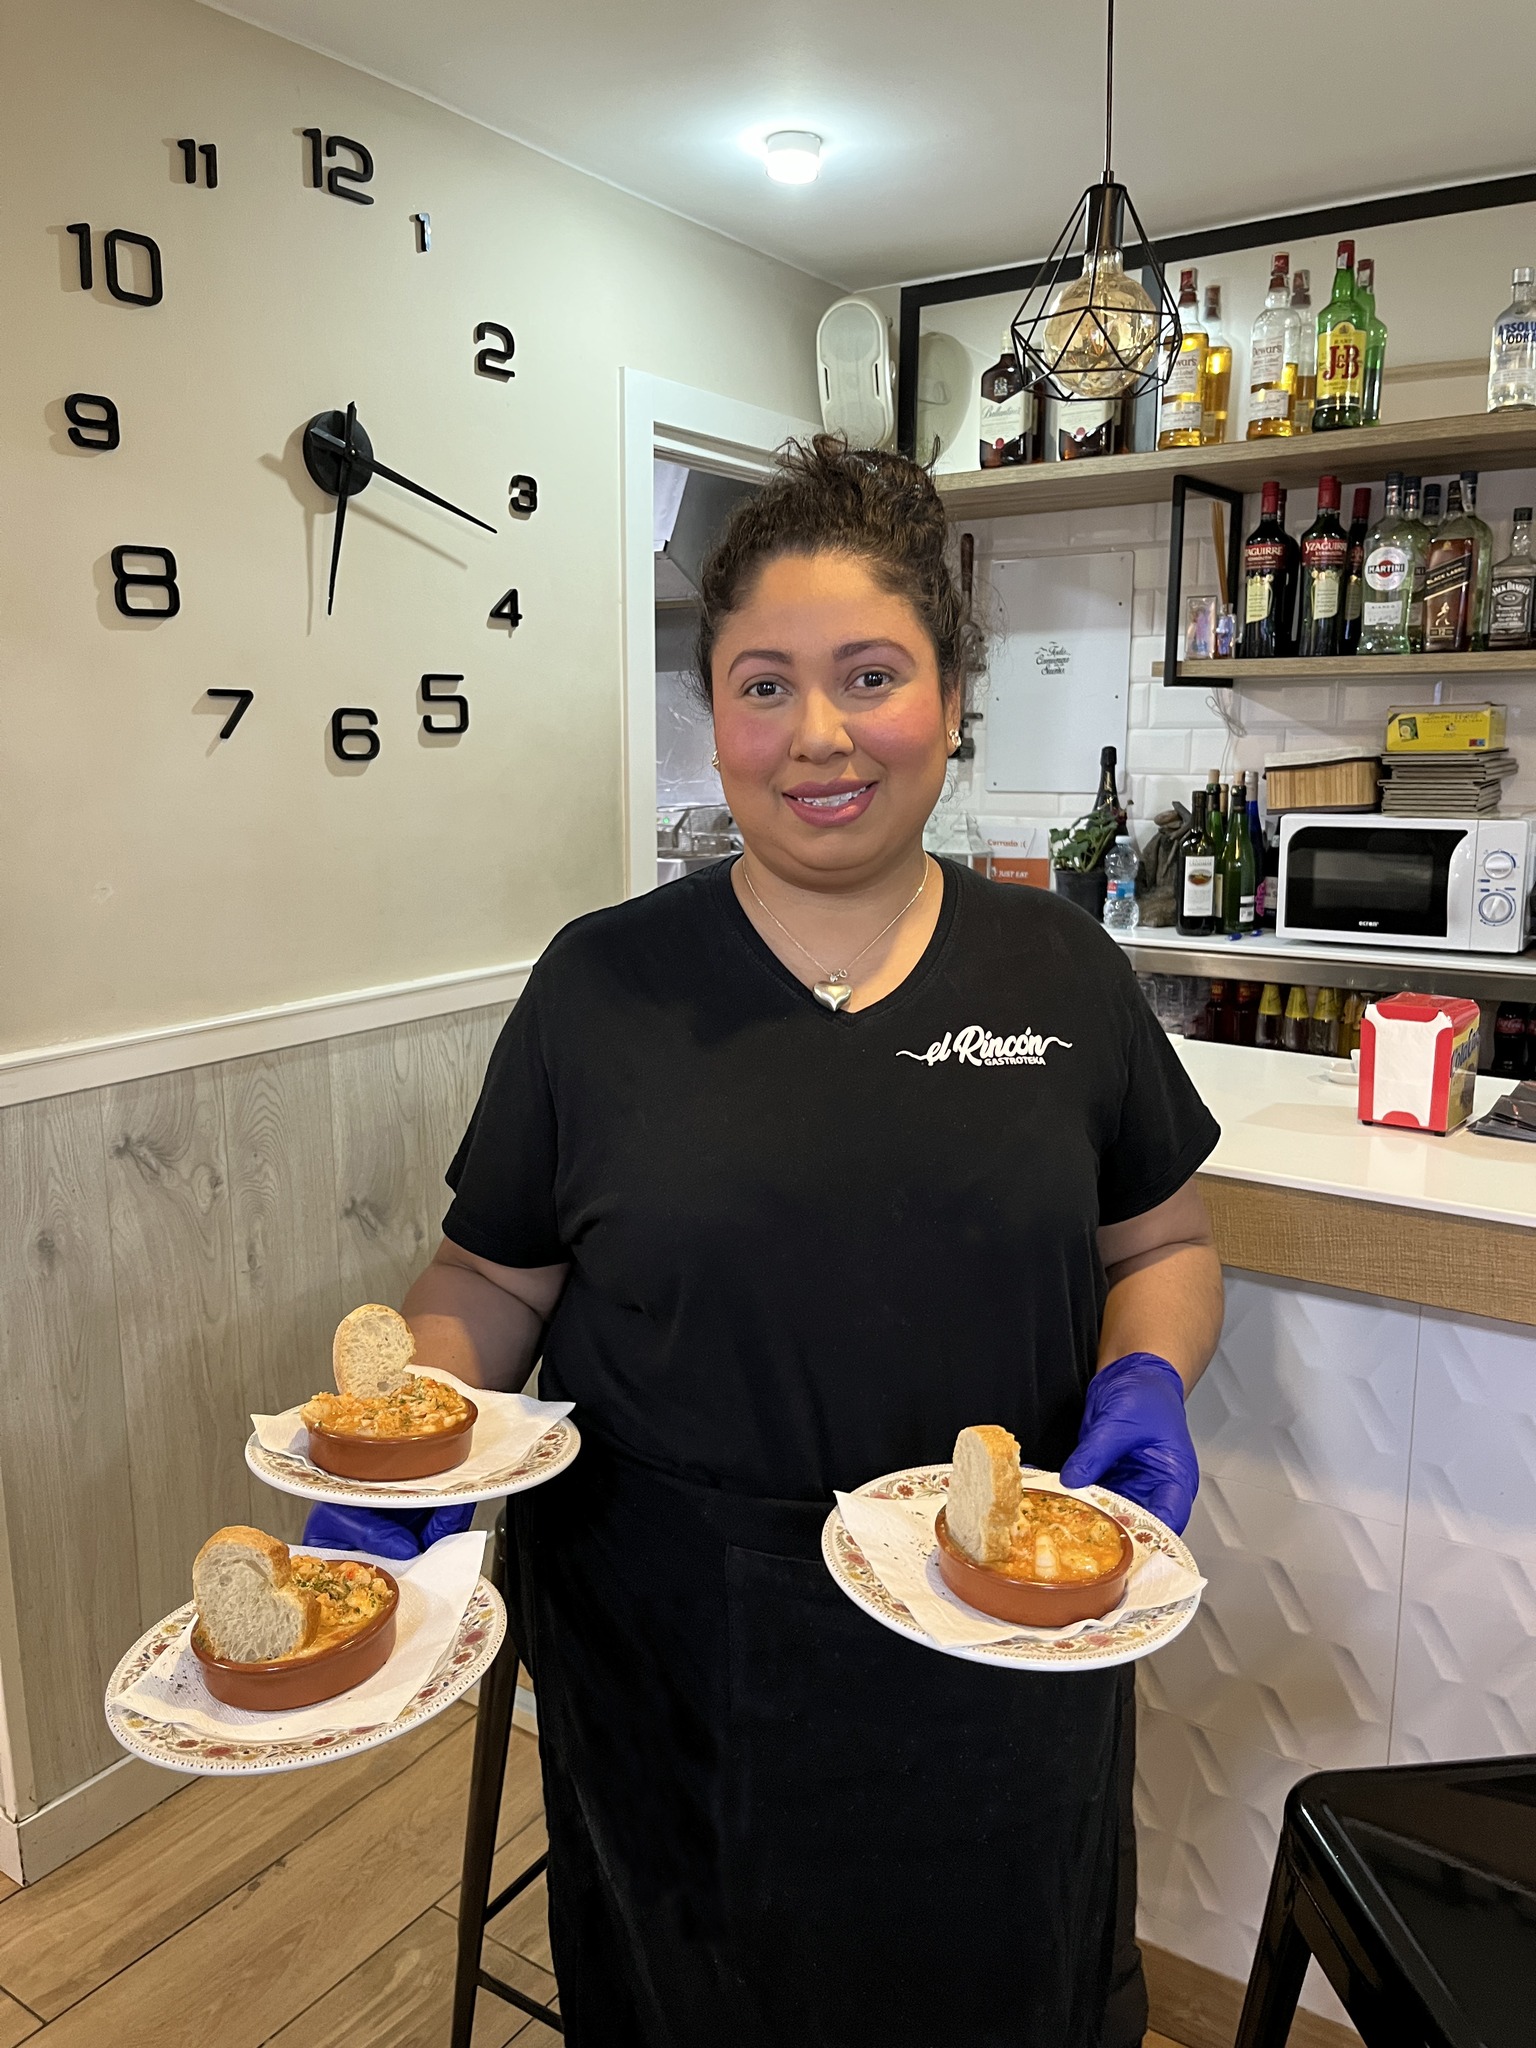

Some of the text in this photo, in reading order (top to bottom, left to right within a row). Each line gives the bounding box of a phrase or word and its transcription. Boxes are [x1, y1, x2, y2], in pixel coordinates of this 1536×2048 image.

[178, 139, 217, 188] 11
[303, 128, 374, 204] 12
[416, 213, 431, 252] 1
[67, 223, 163, 306] 10
[478, 322, 515, 378] 2
[65, 393, 120, 450] 9
[508, 475, 537, 513] 3
[111, 545, 180, 617] 8
[1368, 564, 1405, 574] MARTINI
[490, 588, 522, 628] 4
[207, 688, 254, 739] 7
[421, 674, 469, 734] 5
[332, 708, 380, 761] 6
[998, 870, 1015, 878] JUST
[916, 1025, 1047, 1066] el Rincón
[984, 1056, 1046, 1066] GASTROTEKA
